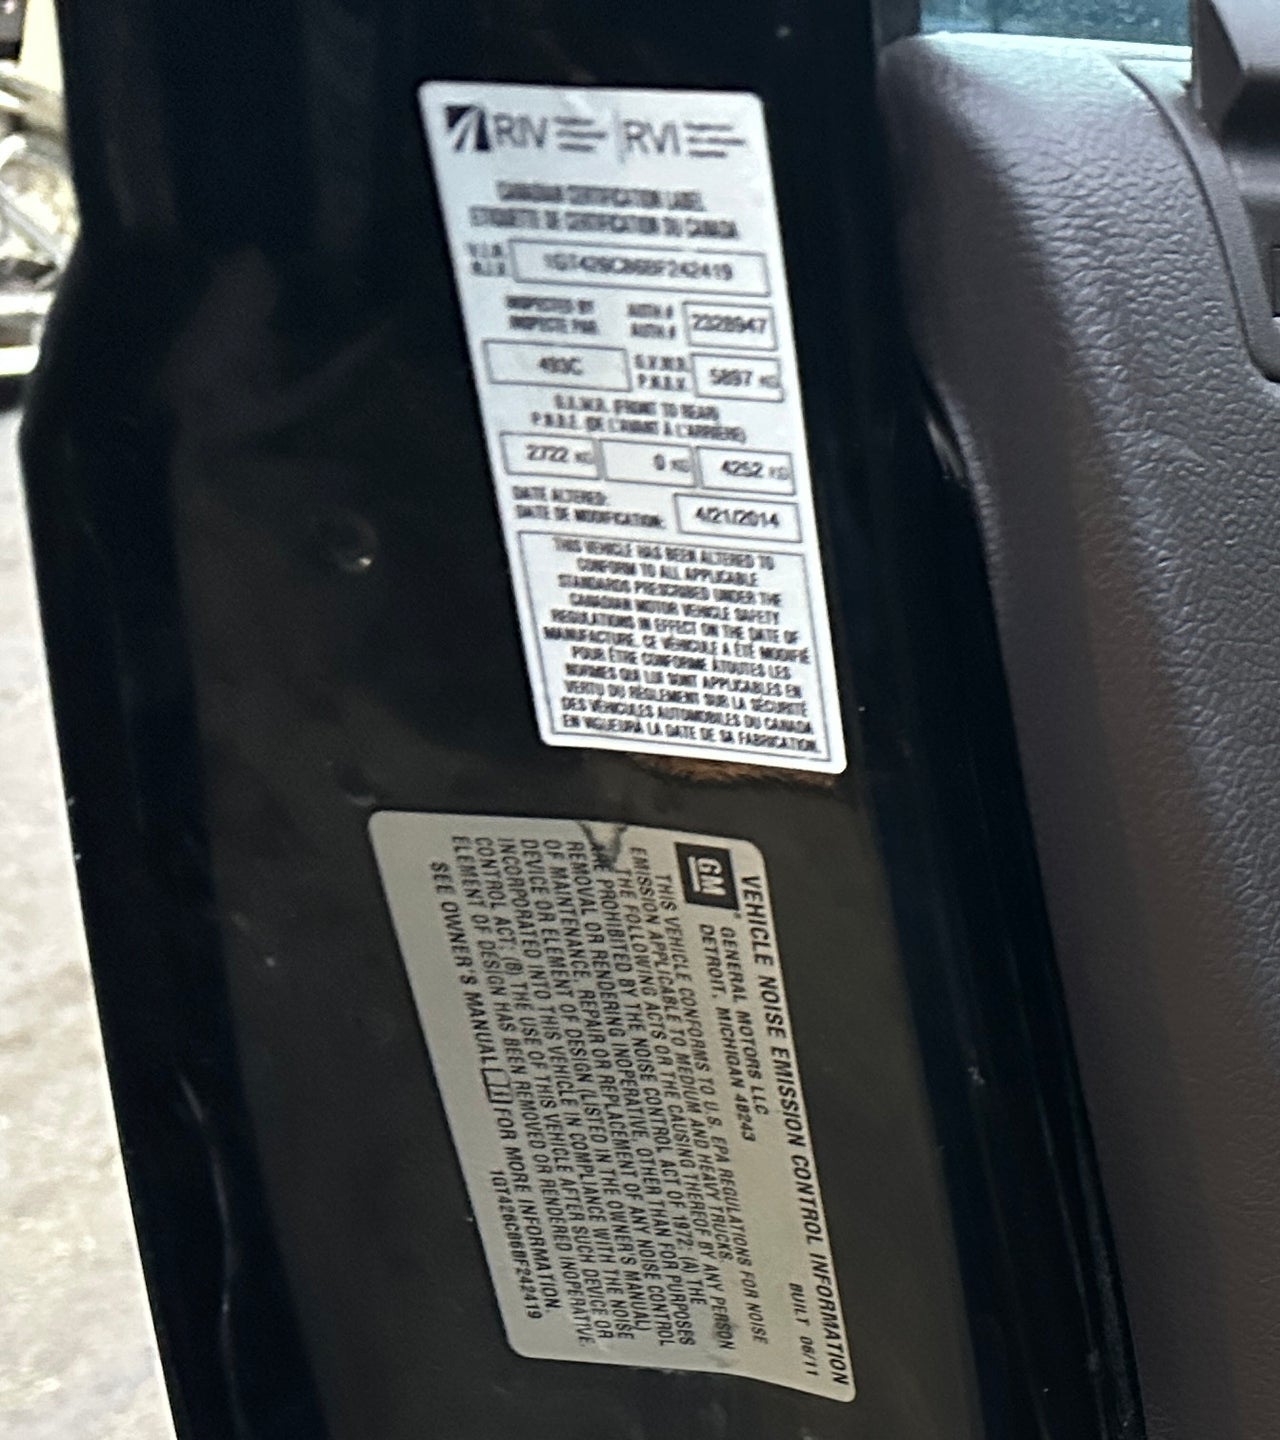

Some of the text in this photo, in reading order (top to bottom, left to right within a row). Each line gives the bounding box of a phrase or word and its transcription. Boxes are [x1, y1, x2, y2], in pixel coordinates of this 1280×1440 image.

[492, 112, 552, 148] RIV
[622, 117, 680, 154] RVI
[525, 444, 569, 462] 2722
[719, 459, 764, 478] 4252
[694, 505, 781, 528] 4/21/2014
[542, 838, 564, 860] OF
[428, 861, 455, 895] SEE
[450, 834, 486, 907] ELEMENT
[473, 836, 509, 910] CONTROL
[565, 840, 598, 915] REMOVAL
[629, 846, 660, 924] EMISSION
[694, 856, 726, 896] GM
[439, 900, 478, 986] OWNER'S
[470, 913, 492, 934] OF
[583, 921, 605, 944] OR
[595, 878, 633, 972] PROHIBITED
[476, 939, 507, 996] DESIGN
[617, 977, 638, 998] BY
[646, 929, 681, 1023] APPLICABLE
[509, 981, 533, 1011] THE
[589, 949, 625, 1037] RENDERING
[462, 991, 499, 1066] MANUAL
[492, 1001, 517, 1033] HAS
[517, 1016, 542, 1046] USE
[577, 989, 606, 1044] REPAIR
[623, 1001, 646, 1032] THE
[668, 1028, 687, 1047] TO
[718, 926, 768, 1115] GENERAL MOTORS LLC
[501, 1037, 528, 1075] BEEN
[526, 1049, 547, 1070] OF
[590, 1048, 612, 1070] OR
[632, 1036, 657, 1081] NOISE
[714, 1006, 744, 1088] MICHIGAN
[496, 837, 635, 1340] INCORPORATED INTO THIS VEHICLE IN COMPLIANCE WITH THE NOISE
[520, 838, 652, 1332] DEVICE OR ELEMENT OF DESIGN (LISTED IN THE OWNER'S MANUAL)
[533, 1075, 558, 1109] THIS
[674, 1052, 702, 1114] MEDIUM
[492, 1107, 518, 1141] FOR
[512, 1079, 546, 1150] REMOVED
[596, 1075, 638, 1177] REPLACEMENT
[615, 868, 735, 1350] THE FOLLOWING ACTS OR THE CAUSING THEREOF BY ANY PERSON
[643, 1087, 673, 1154] CONTROL
[653, 873, 768, 1344] THIS VEHICLE CONFORMS TO U.S. EPA REGULATIONS FOR NOISE
[739, 874, 849, 1385] VEHICLE NOISE EMISSION CONTROL INFORMATION
[542, 1113, 573, 1173] VEHICLE
[688, 1117, 710, 1149] AND
[503, 1145, 532, 1194] MORE
[531, 1153, 553, 1174] OR
[635, 1147, 663, 1196] OTHER
[659, 1159, 680, 1183] ACT
[696, 1153, 721, 1200] HEAVY
[559, 1177, 585, 1222] AFTER
[623, 1182, 643, 1201] OF
[666, 1190, 686, 1209] OF
[538, 1178, 572, 1252] RENDERED
[628, 1205, 651, 1233] ANY
[648, 1200, 672, 1237] THAN
[570, 1224, 595, 1263] SUCH
[636, 1238, 661, 1280] NOISE
[657, 1242, 679, 1270] FOR
[678, 1255, 700, 1273] (A)
[581, 1267, 608, 1316] DEVICE
[664, 1273, 696, 1347] PURPOSES
[685, 1279, 707, 1305] THE
[594, 1319, 614, 1339] OR
[647, 1284, 677, 1348] CONTROL
[787, 1282, 819, 1376] BUILT 06/11
